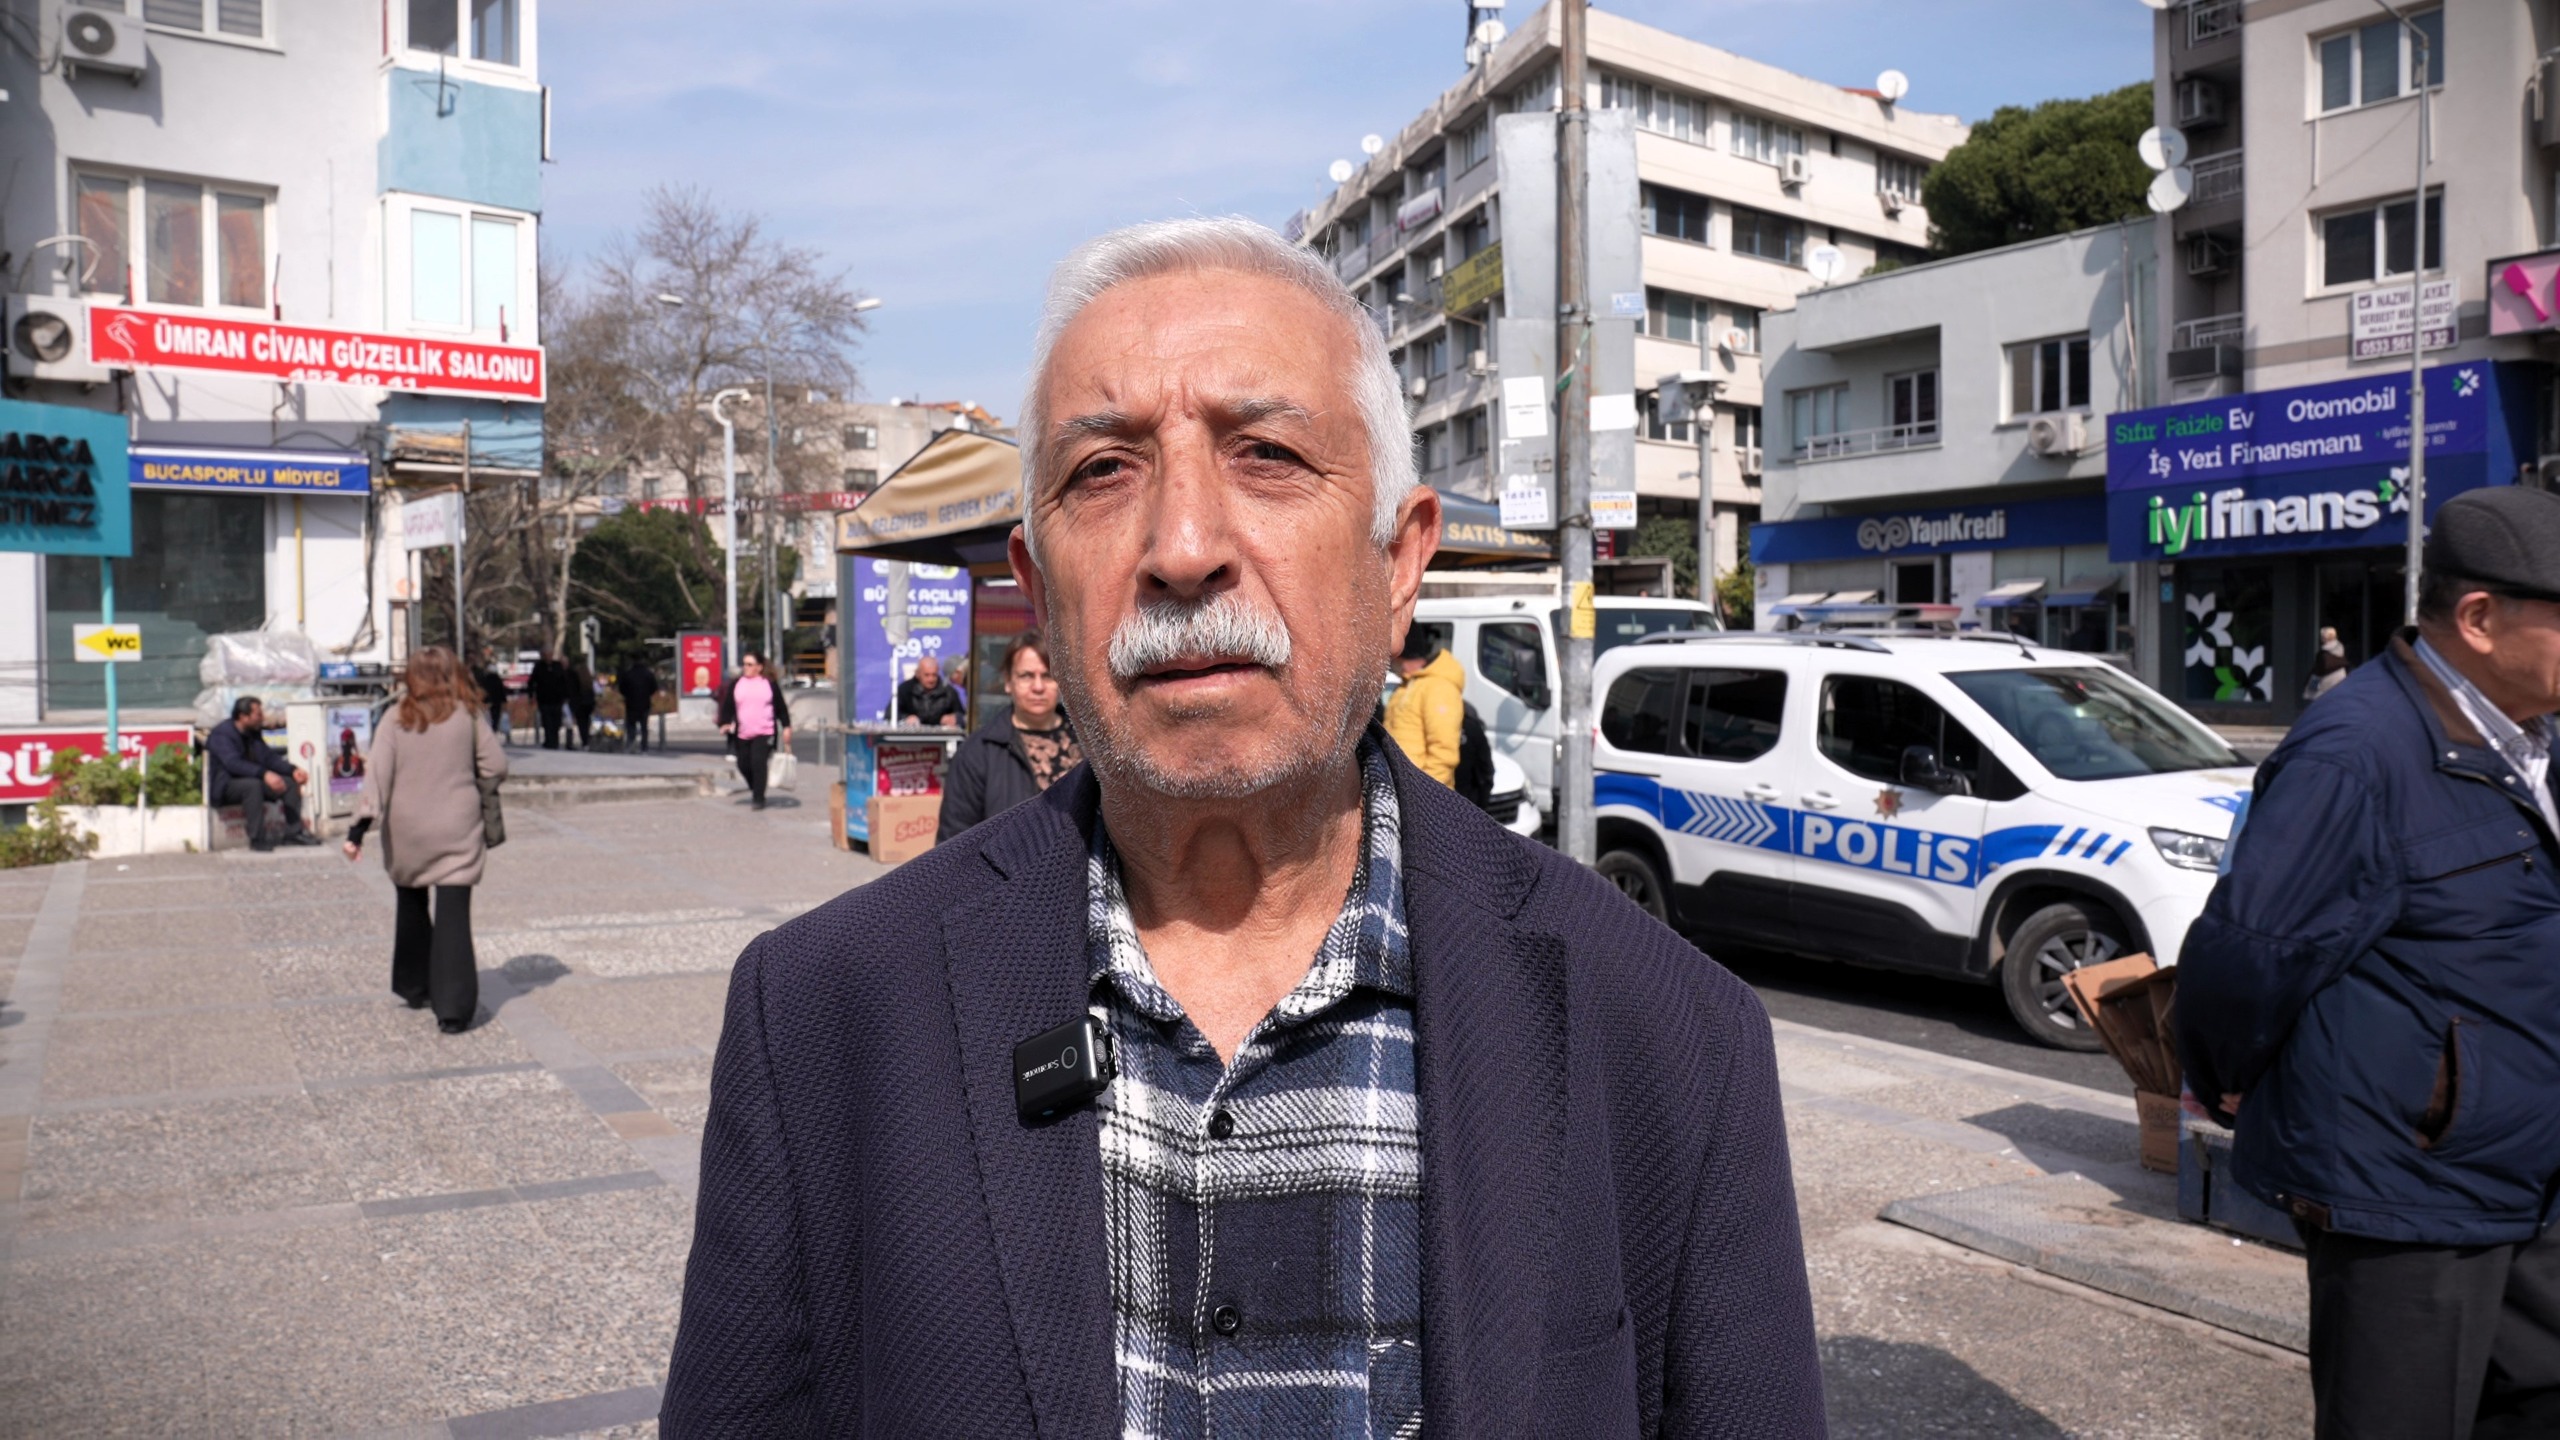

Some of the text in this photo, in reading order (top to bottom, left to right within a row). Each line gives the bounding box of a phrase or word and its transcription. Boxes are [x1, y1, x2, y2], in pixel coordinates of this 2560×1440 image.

[153, 317, 535, 384] ÜMRAN CİVAN GÜZELLİK SALONU
[2165, 413, 2224, 438] Faizle
[2228, 408, 2255, 431] Ev
[2286, 386, 2397, 423] Otomobil
[2149, 433, 2363, 478] İş Yeri Finansmanı
[143, 463, 341, 488] BUCASPOR'LU MİDYECİ
[1447, 523, 1507, 547] SATIŞ
[1908, 510, 2005, 547] YapıKredi
[2148, 487, 2380, 555] iyifinans
[107, 637, 136, 650] WC
[1022, 1059, 1060, 1082] Saramonic
